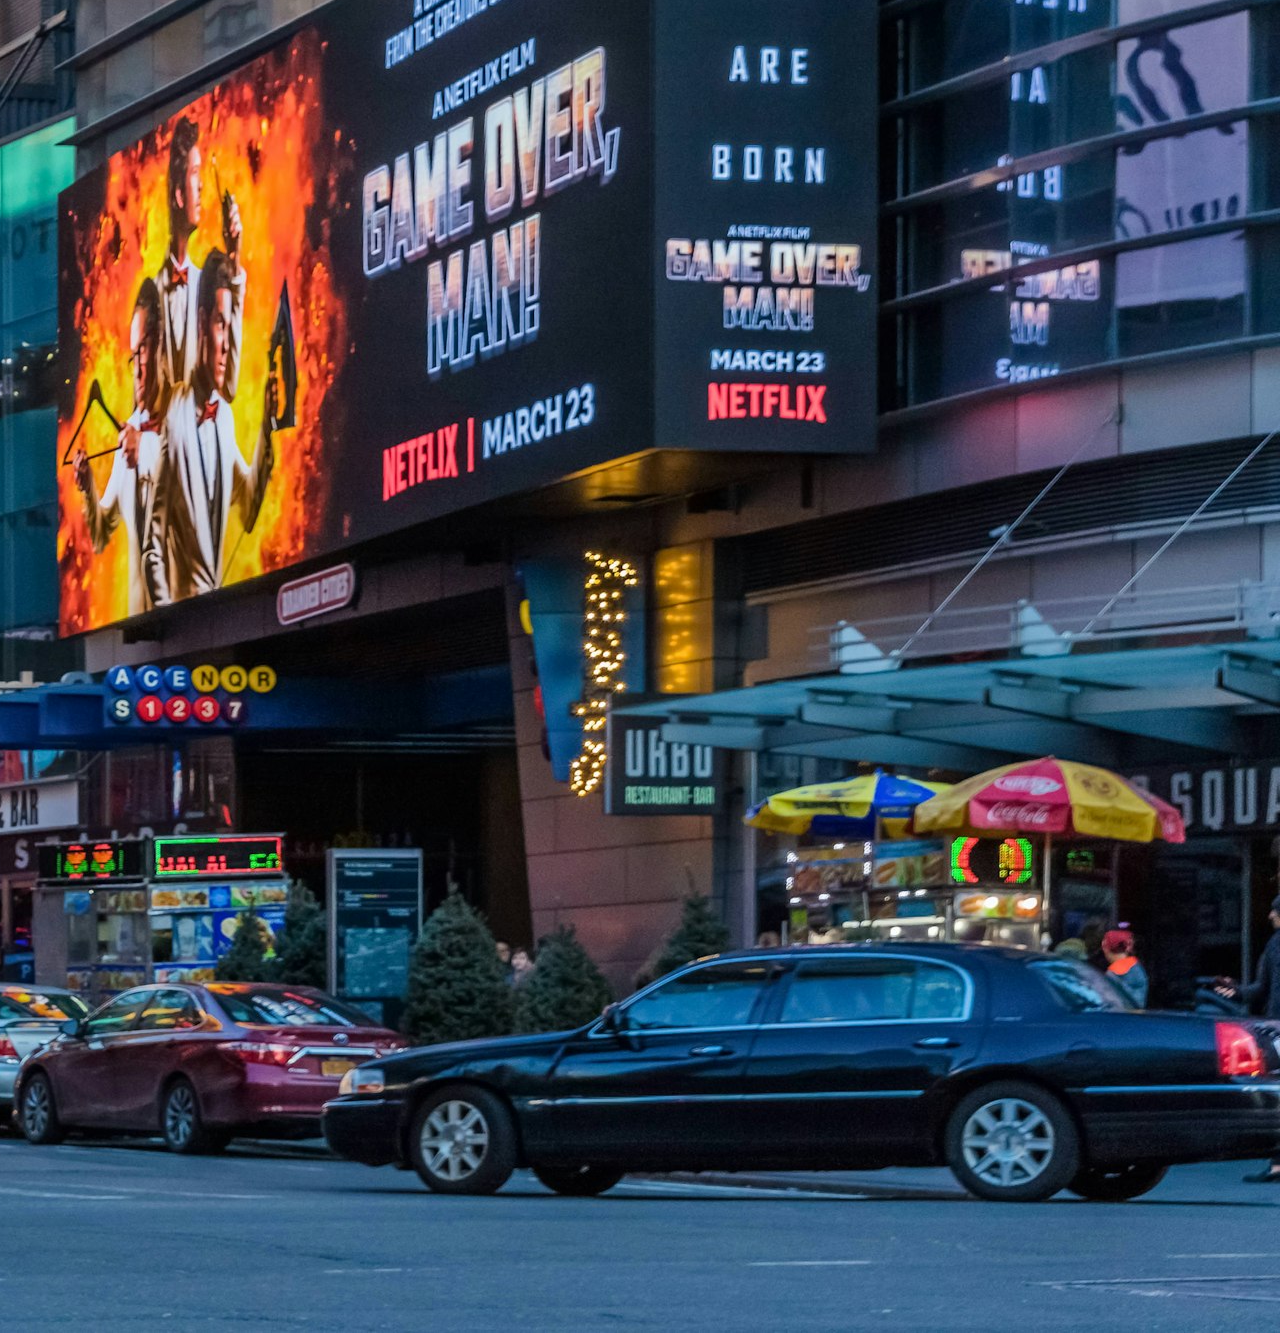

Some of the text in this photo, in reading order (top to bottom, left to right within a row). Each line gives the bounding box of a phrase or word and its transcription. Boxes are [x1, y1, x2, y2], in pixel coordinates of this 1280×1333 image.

[385, 27, 415, 69] FROM
[414, 13, 435, 50] THE
[432, 37, 536, 119] A NETFLIX FILM
[729, 46, 809, 85] ARE
[363, 46, 622, 277] GAME OVER,
[712, 143, 826, 184] BORN
[727, 225, 810, 240] A NETFLIX FILM
[666, 238, 871, 293] GAME OVER,
[427, 212, 541, 380] MAN!
[723, 285, 815, 331] MAN!
[710, 349, 825, 372] MARCH 23
[708, 382, 827, 424] NETFLIX
[382, 383, 595, 501] NETFLIX MARCH 23
[115, 669, 270, 689] A C E N Q R
[115, 700, 241, 719] S 1 2 3 7
[9, 789, 40, 827] BAR
